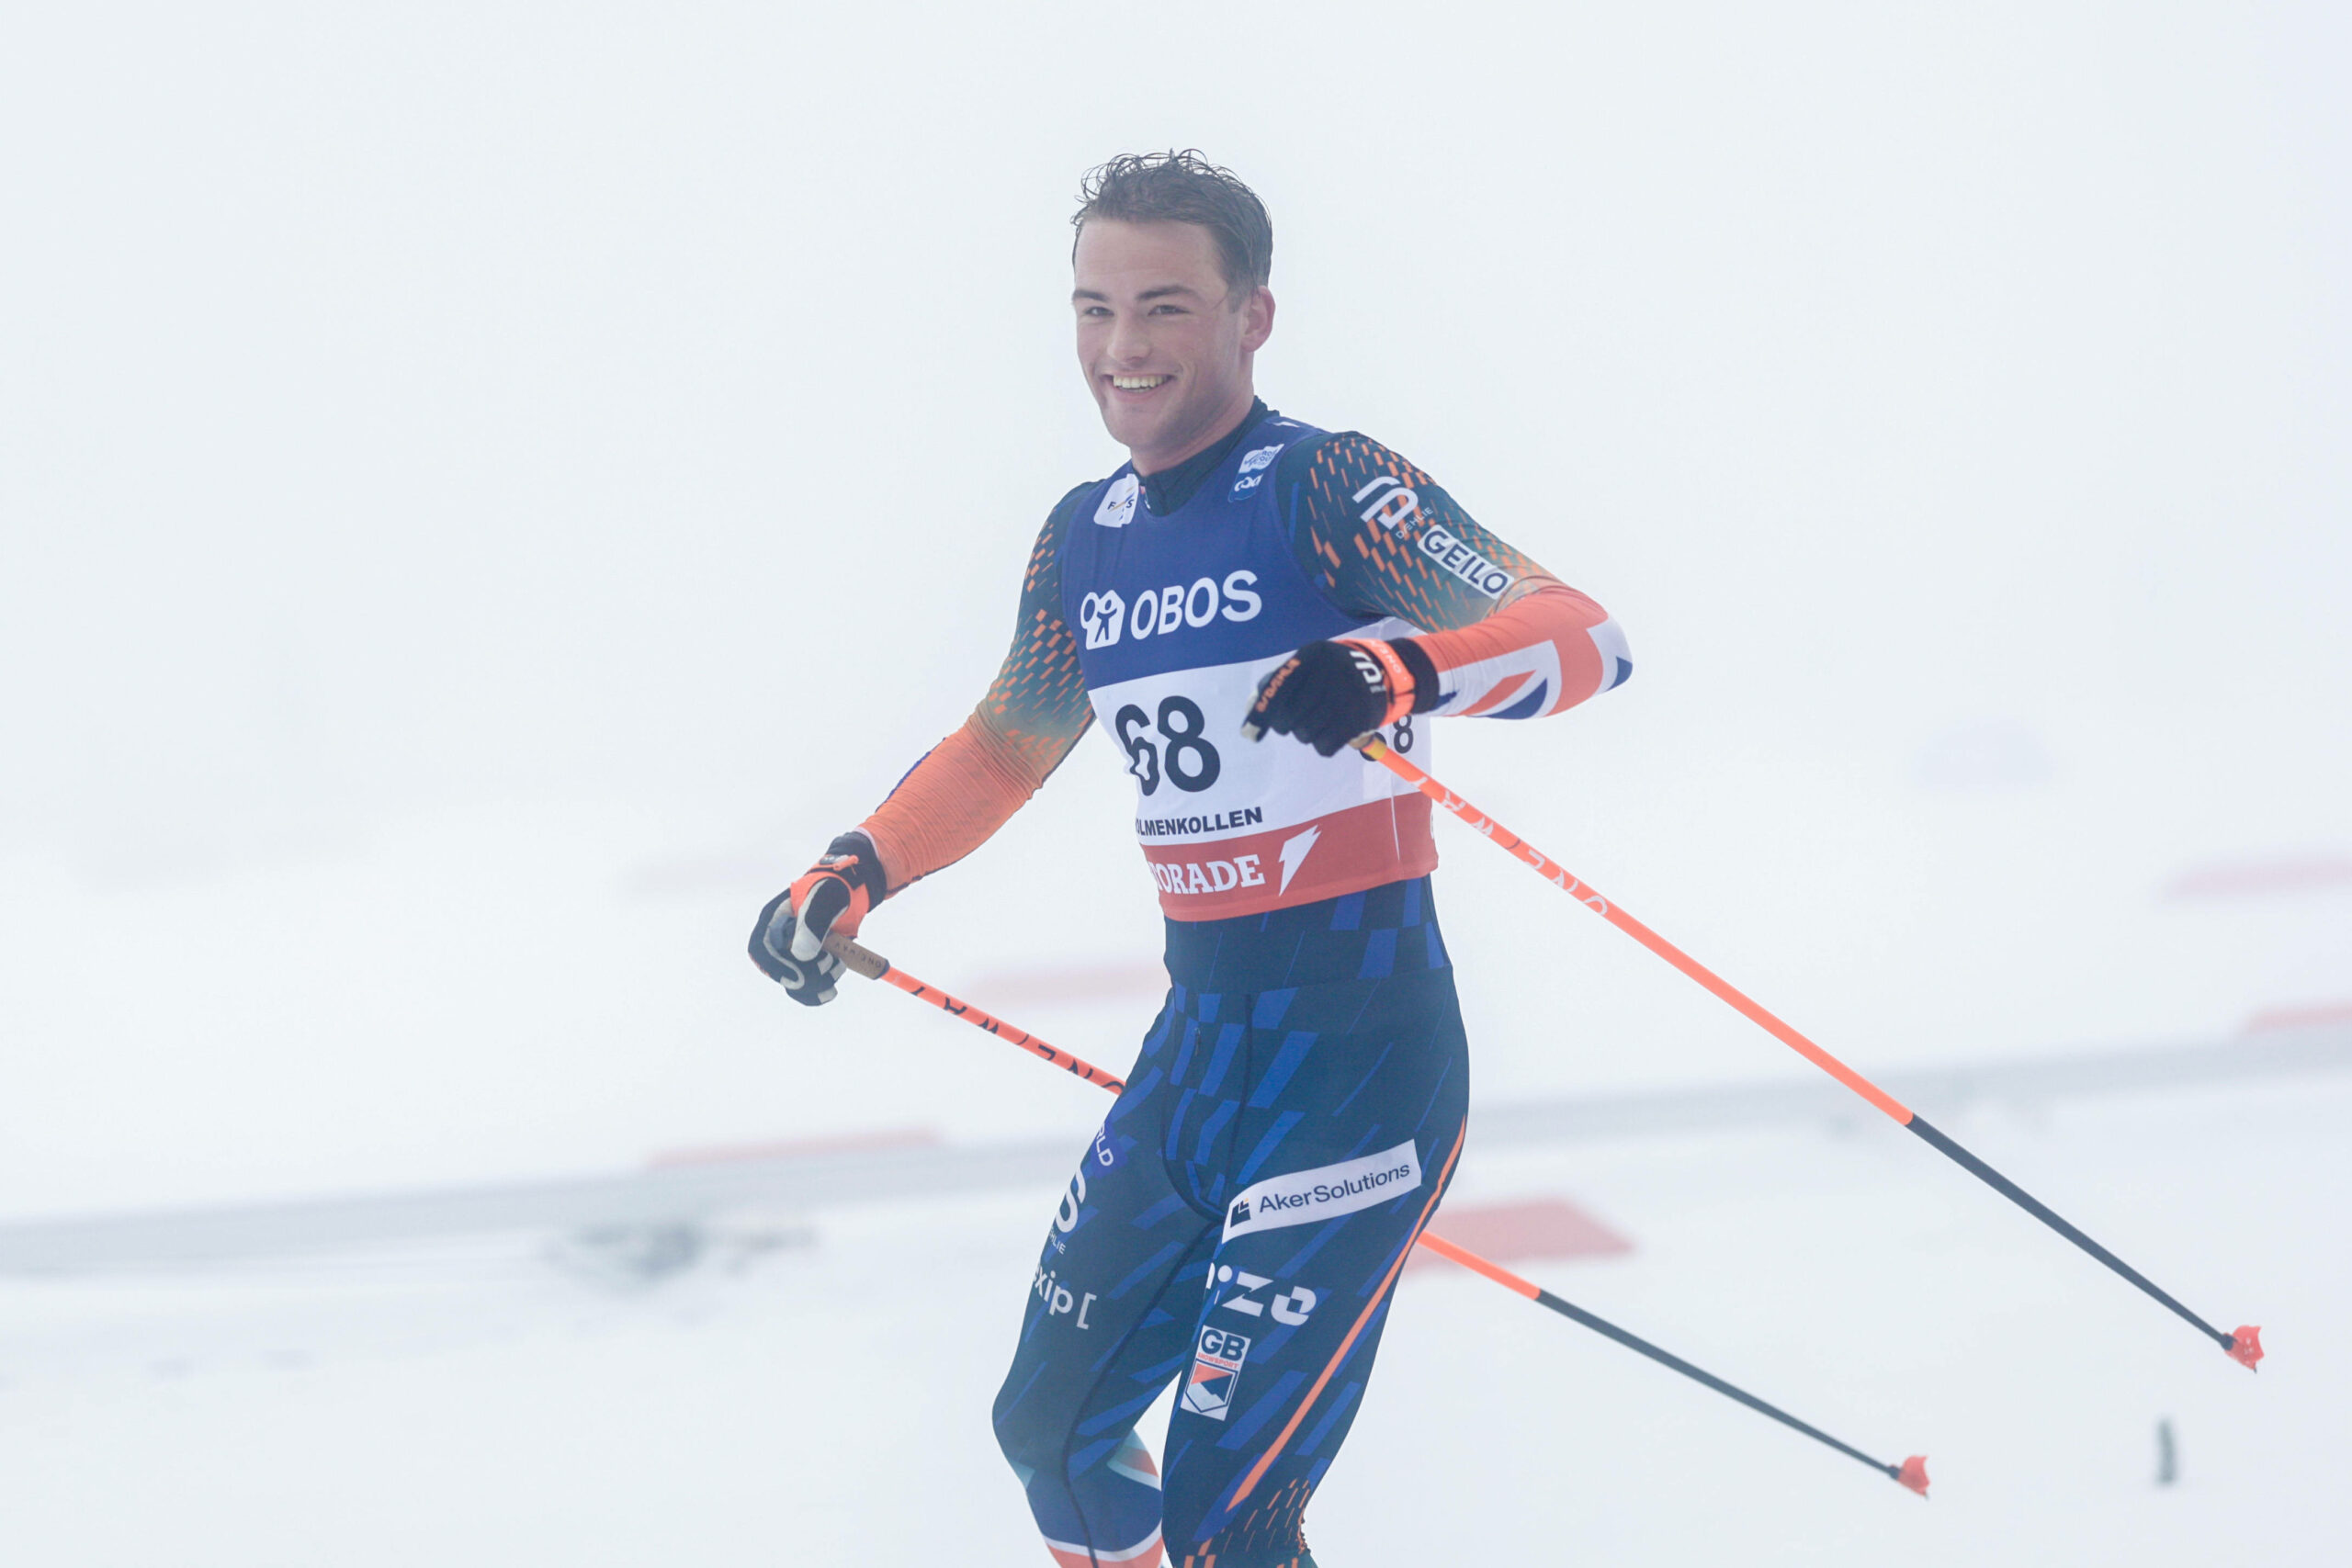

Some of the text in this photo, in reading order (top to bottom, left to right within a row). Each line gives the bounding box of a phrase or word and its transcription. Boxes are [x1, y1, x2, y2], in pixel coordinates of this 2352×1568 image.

[1424, 530, 1509, 594] GEILO
[1130, 570, 1262, 640] OBOS
[1114, 695, 1221, 796] 68
[1201, 1329, 1246, 1361] GB
